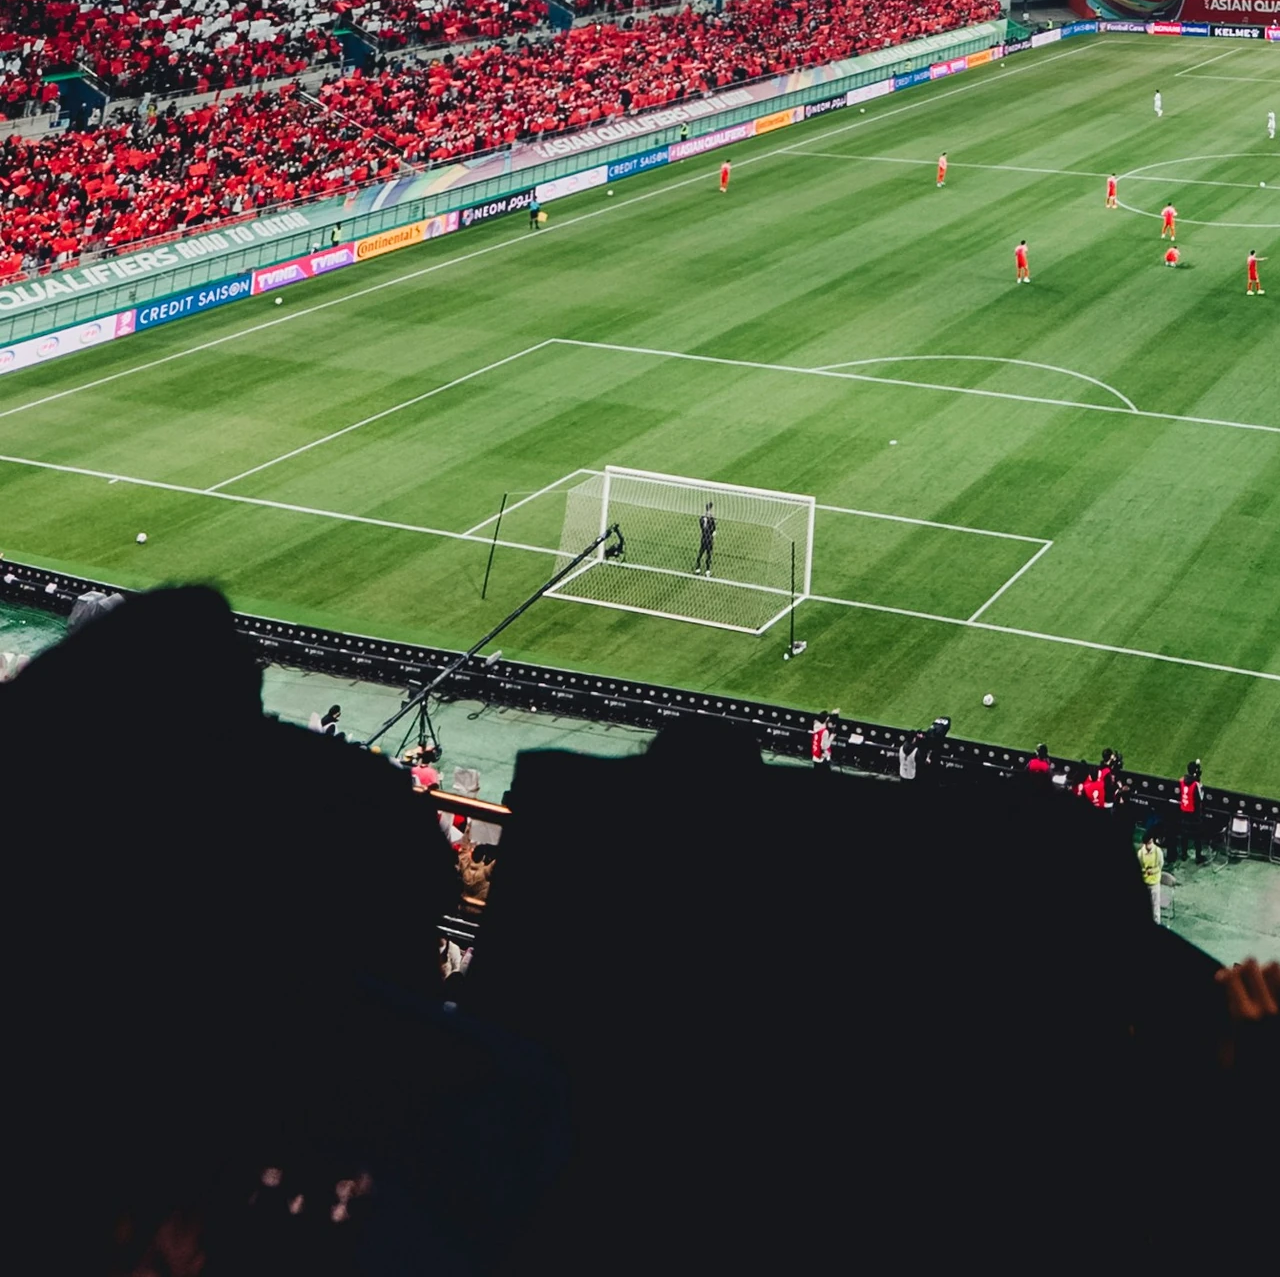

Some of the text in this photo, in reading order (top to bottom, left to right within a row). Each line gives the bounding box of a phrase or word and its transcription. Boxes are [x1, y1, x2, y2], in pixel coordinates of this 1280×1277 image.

[1214, 27, 1251, 37] KELME
[543, 130, 598, 157] ASIAN
[597, 107, 689, 142] QUALIFIERS
[609, 157, 637, 177] CREDIT
[640, 149, 668, 168] SAISON
[474, 200, 506, 220] NEOM
[357, 229, 414, 258] Continental
[0, 211, 310, 310] QUALIFIERS ROAD TO QATAR
[258, 264, 297, 289] TVING
[139, 295, 194, 324] CREDIT
[198, 279, 250, 307] SAISON
